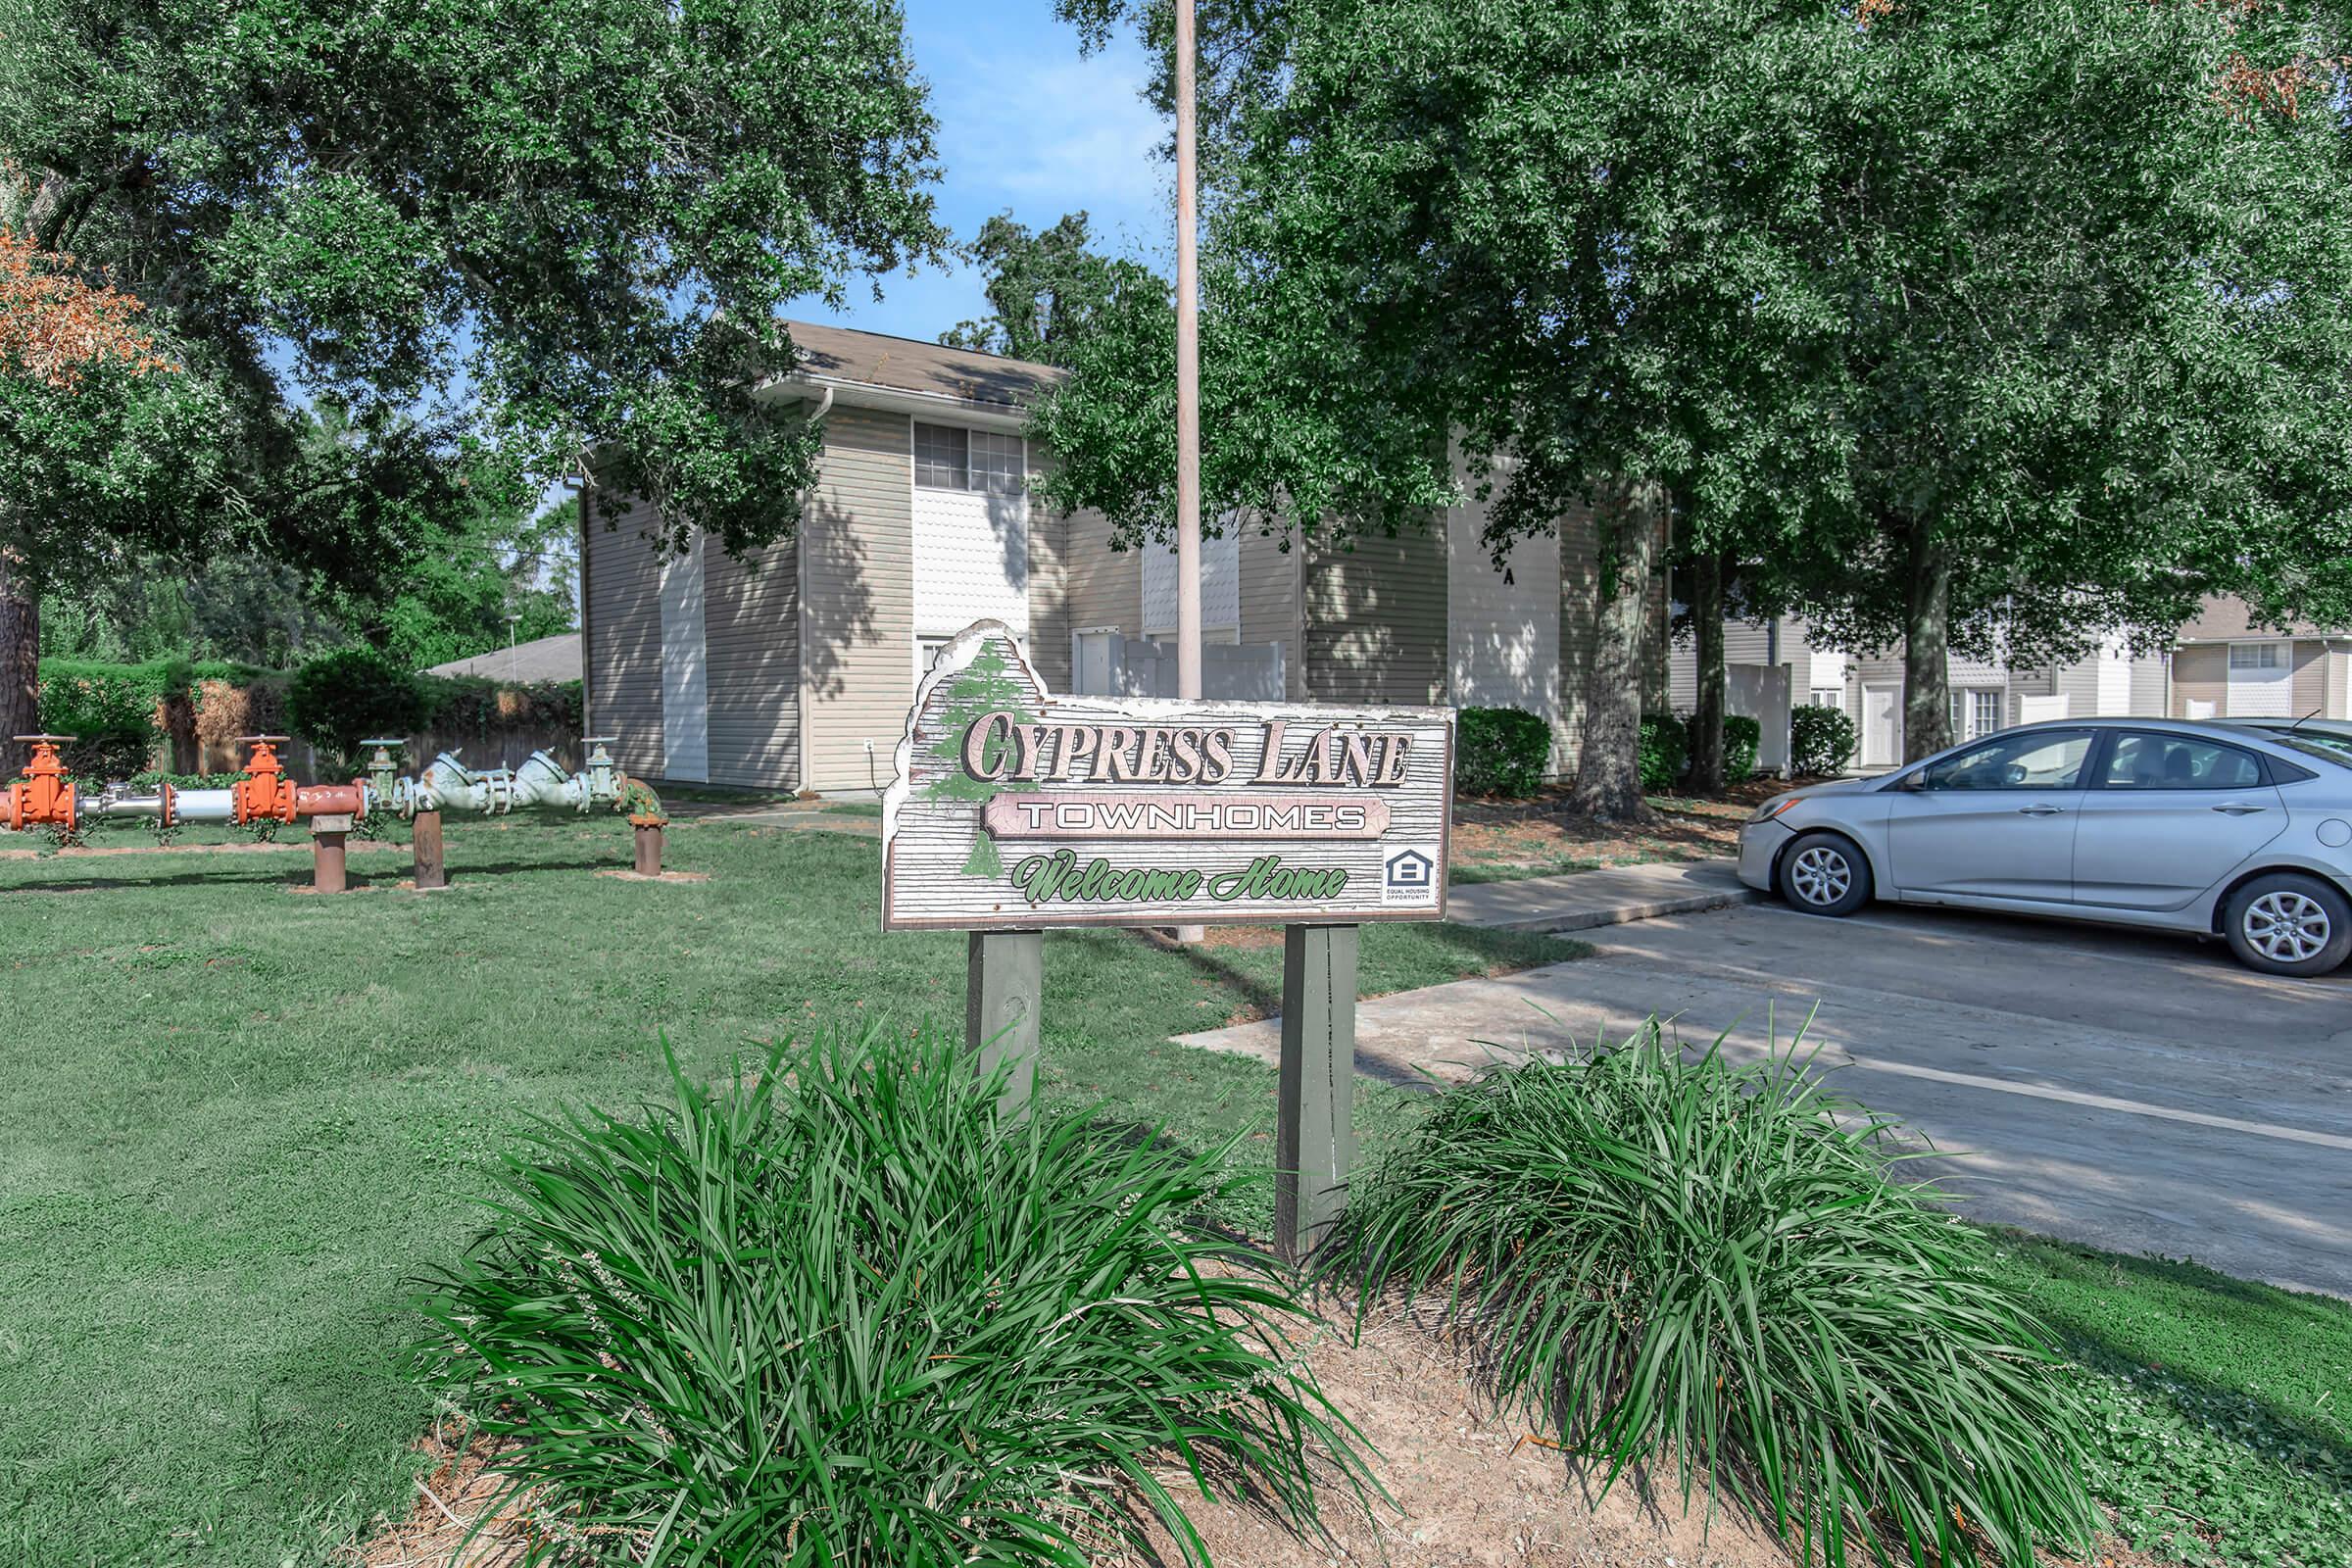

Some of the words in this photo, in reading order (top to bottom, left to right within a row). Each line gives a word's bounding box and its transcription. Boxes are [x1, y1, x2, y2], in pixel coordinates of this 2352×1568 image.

[1503, 568, 1515, 585] A
[960, 710, 1236, 785] CYPRESS
[1248, 720, 1414, 788] LANE
[1017, 802, 1367, 831] TOWNHOMES
[1011, 849, 1203, 903] Welcome
[1207, 855, 1349, 901] Home
